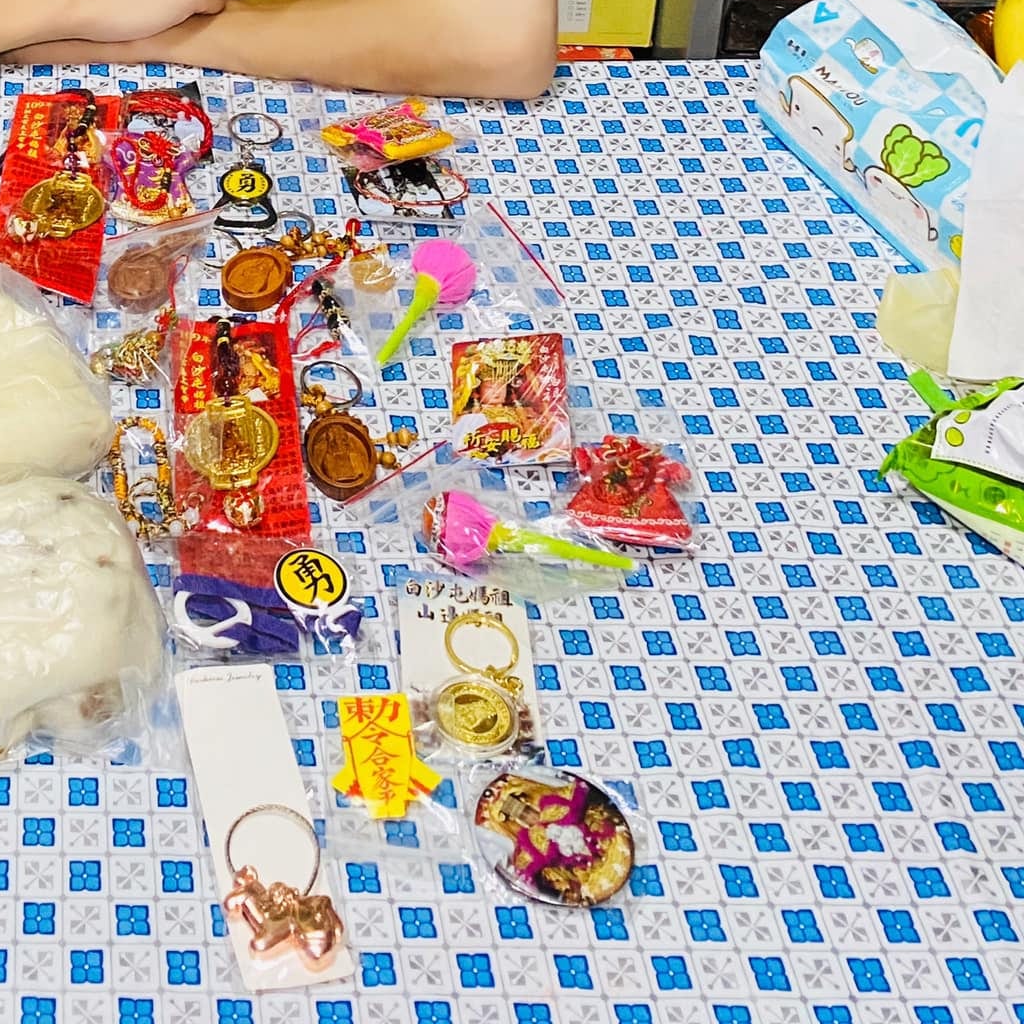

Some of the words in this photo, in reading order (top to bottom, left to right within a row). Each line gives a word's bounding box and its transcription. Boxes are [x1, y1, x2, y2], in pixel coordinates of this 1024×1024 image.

[236, 173, 256, 193] 勇
[289, 554, 336, 605] 勇
[406, 579, 513, 607] 白沙屯媽祖
